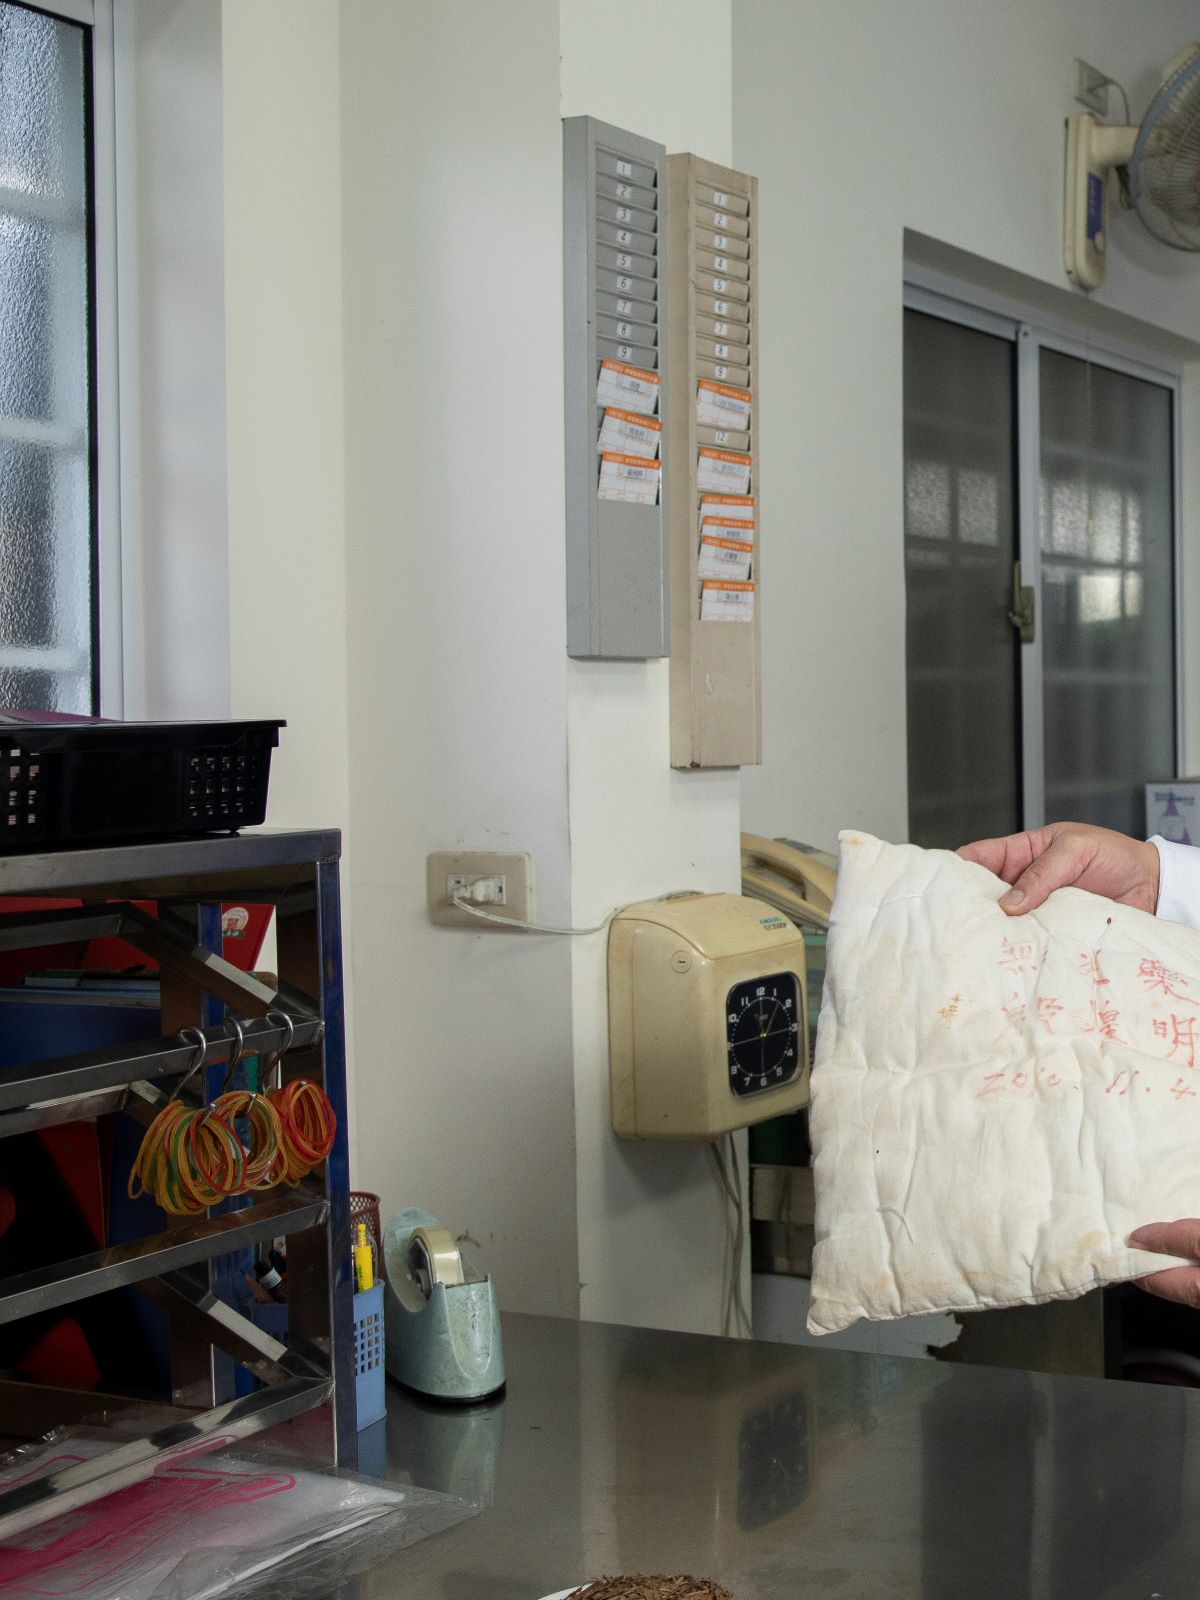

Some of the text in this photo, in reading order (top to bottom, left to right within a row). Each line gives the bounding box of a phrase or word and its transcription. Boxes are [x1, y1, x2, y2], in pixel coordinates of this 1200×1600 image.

[620, 185, 627, 196] 2
[621, 208, 627, 219] 3
[621, 255, 627, 266] 5
[621, 278, 627, 288] 6
[621, 301, 627, 311] 7
[621, 324, 627, 335] 8
[622, 347, 627, 357] 9
[717, 432, 726, 441] 12
[756, 986, 766, 996] 12
[741, 996, 749, 1006] 11
[785, 999, 792, 1008] 2
[729, 1013, 737, 1023] 10
[791, 1023, 798, 1032] 3
[786, 1048, 794, 1057] 4
[776, 1066, 783, 1076] 5
[744, 1076, 751, 1086] 7
[760, 1077, 767, 1086] 6
